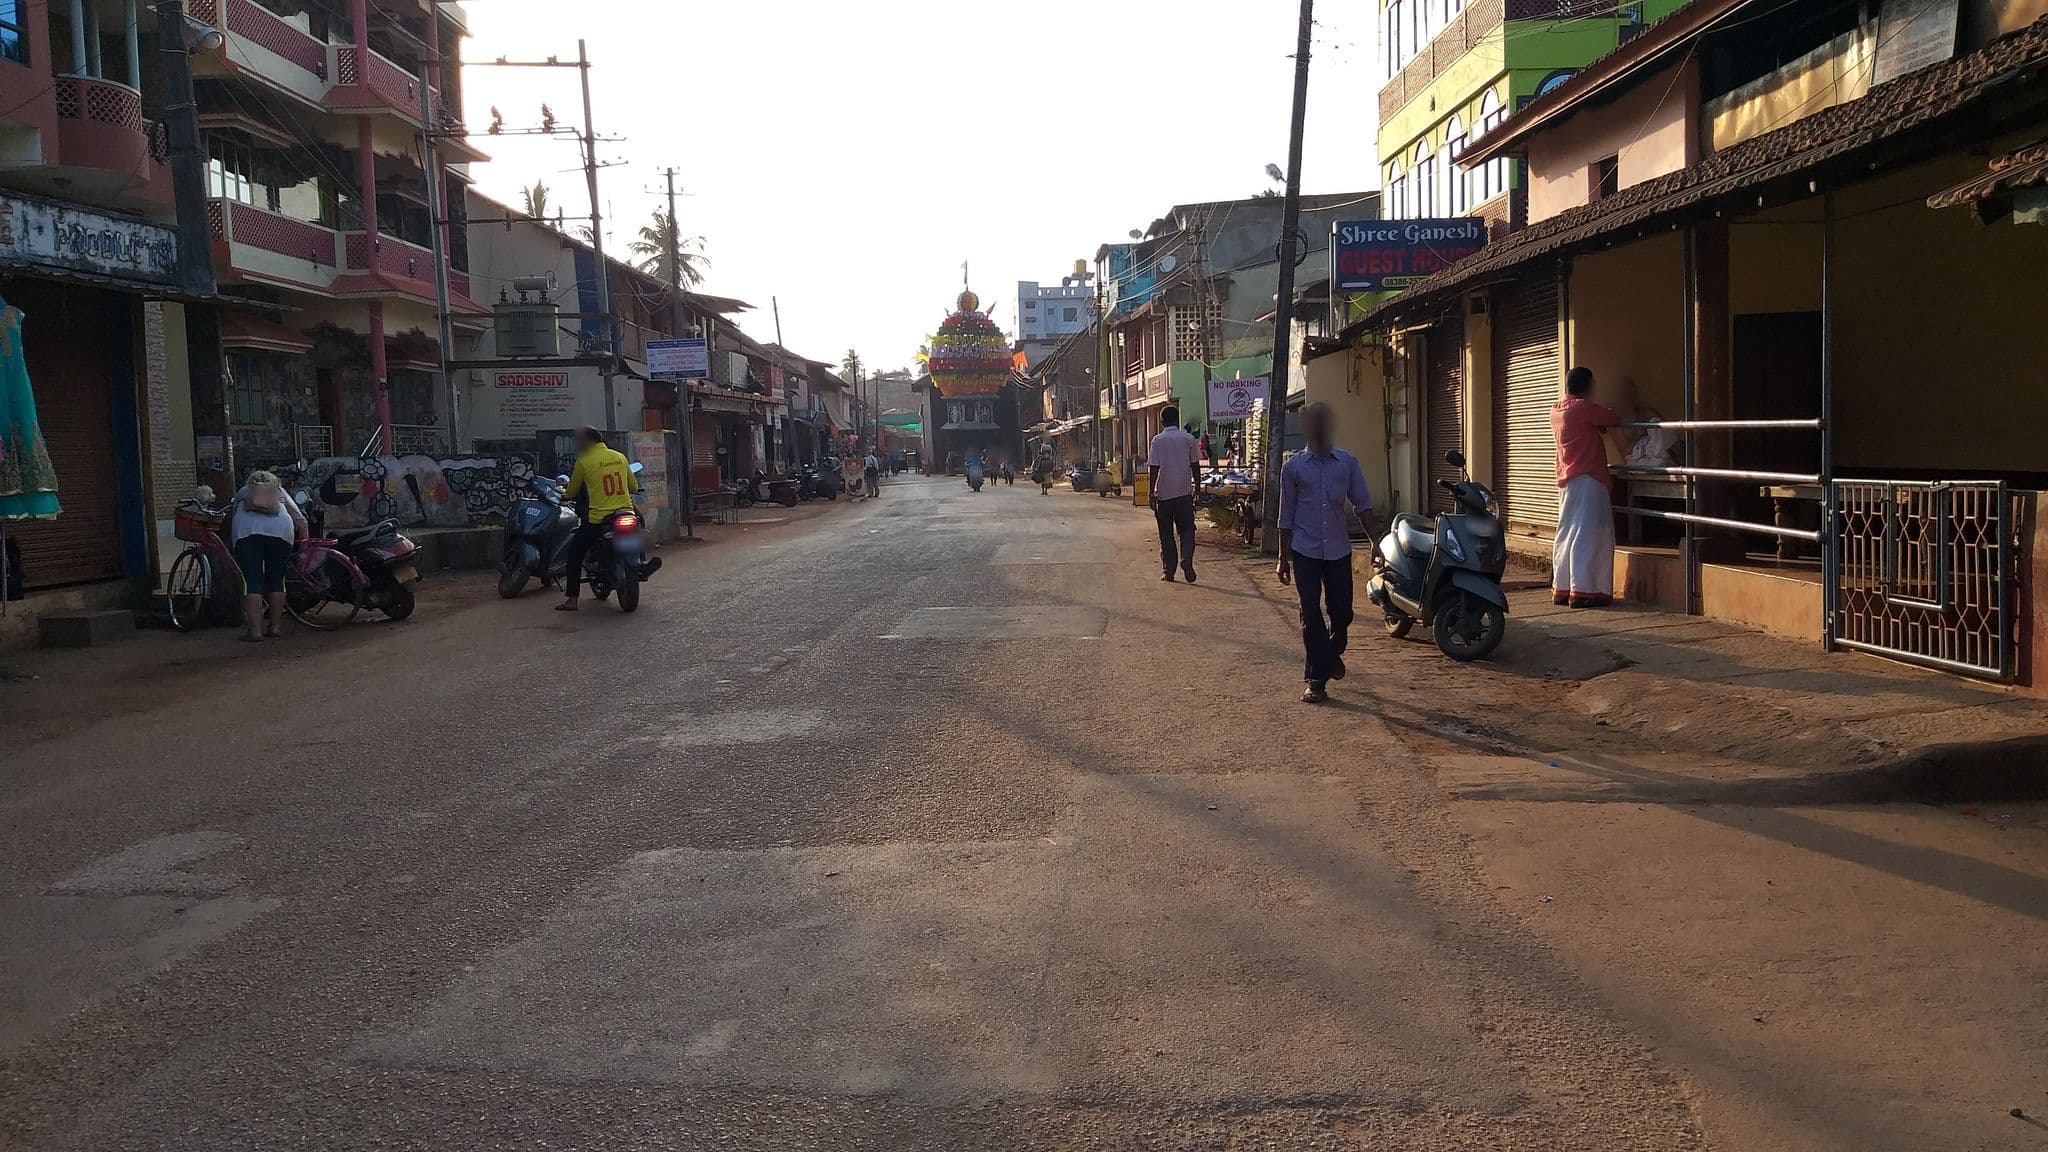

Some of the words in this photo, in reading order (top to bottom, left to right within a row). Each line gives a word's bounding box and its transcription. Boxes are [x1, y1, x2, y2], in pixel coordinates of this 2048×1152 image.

[1340, 226, 1399, 245] Shree
[1404, 222, 1478, 245] Ganesh
[1340, 248, 1406, 275] GUEST
[498, 375, 565, 386] SADASHIV
[1226, 379, 1261, 388] PARKING
[603, 471, 625, 496] 01
